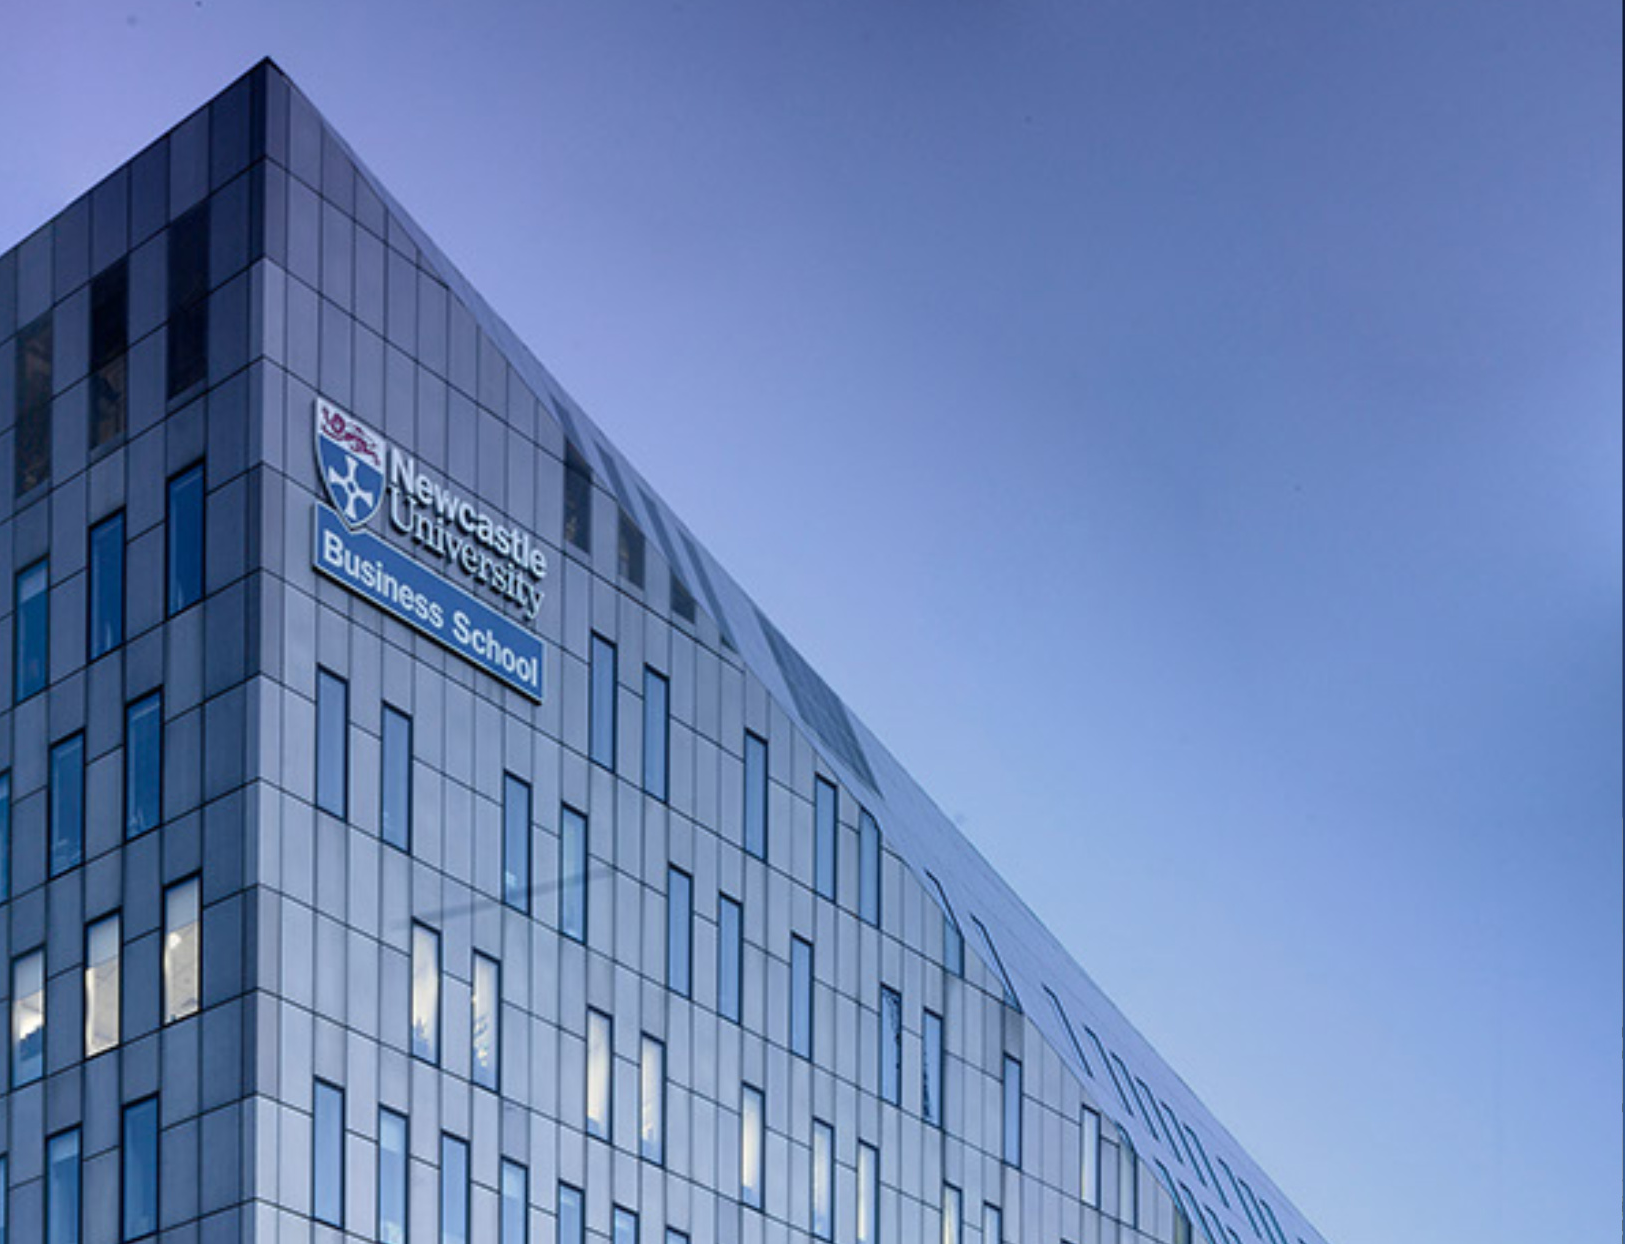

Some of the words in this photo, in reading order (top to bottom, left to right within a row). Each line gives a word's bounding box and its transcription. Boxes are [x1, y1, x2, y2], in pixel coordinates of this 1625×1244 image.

[389, 448, 547, 578] Newcastle
[390, 486, 544, 619] University
[324, 530, 444, 628] Business
[452, 611, 539, 687] School
